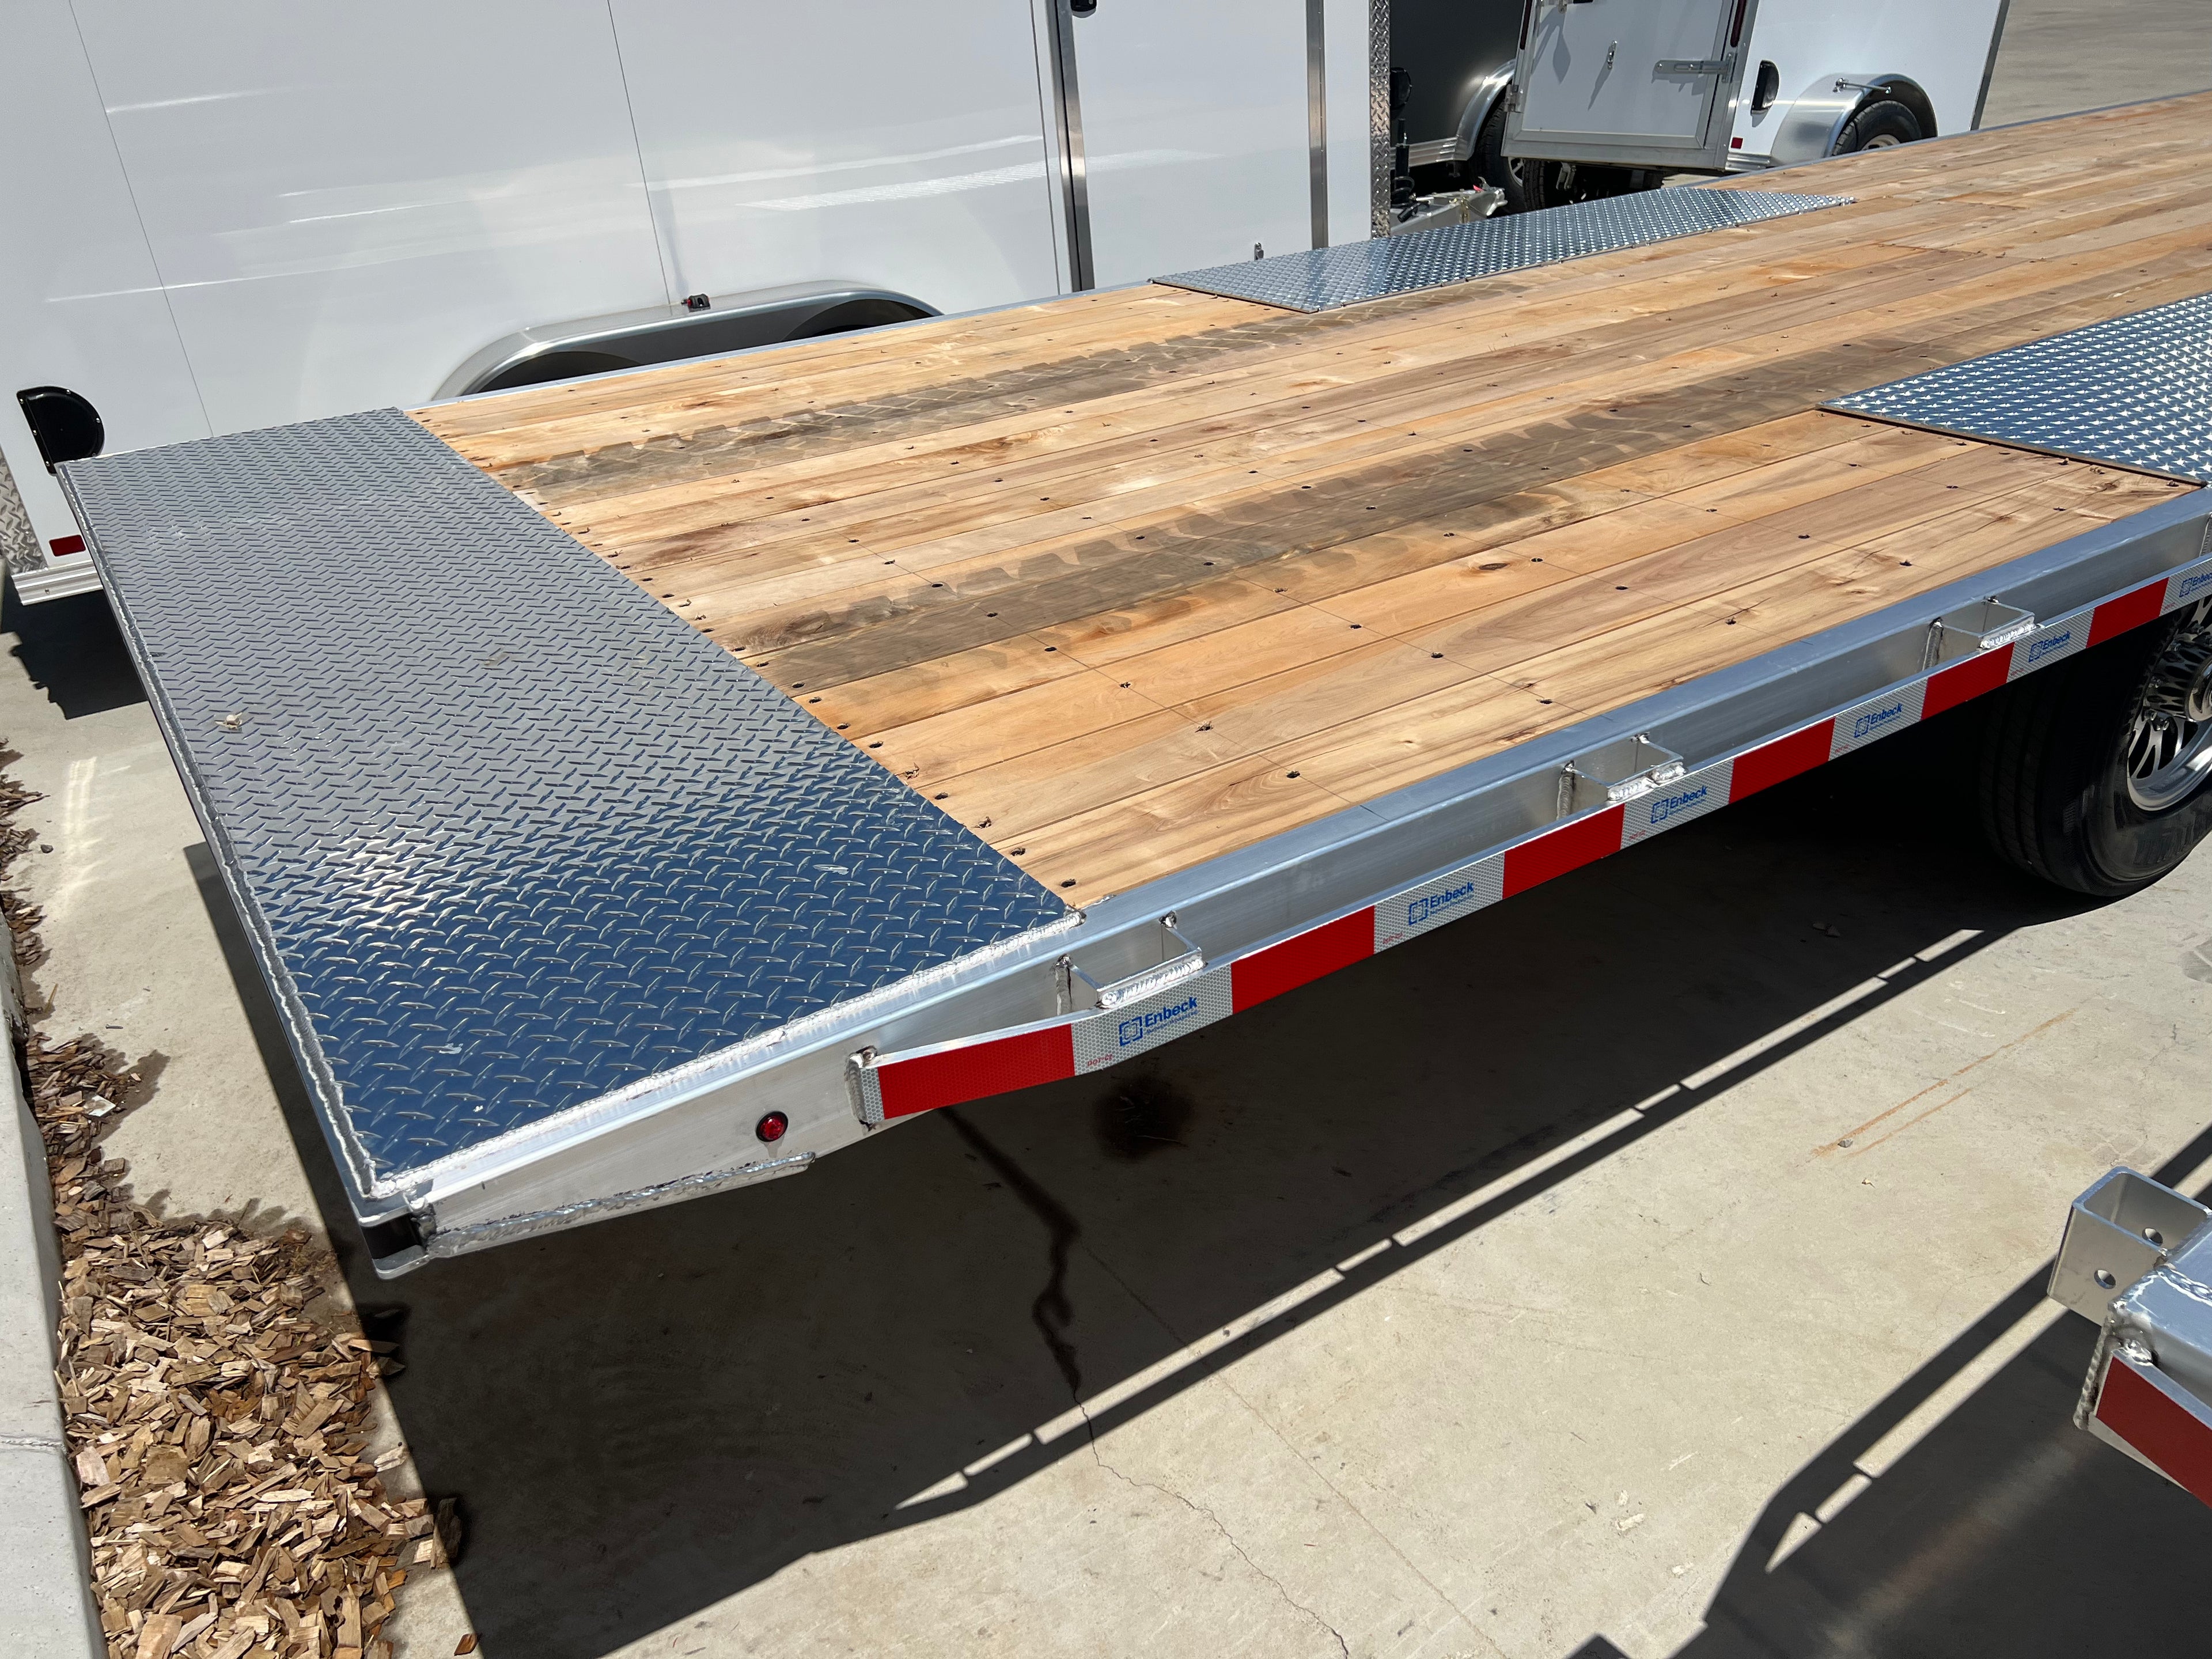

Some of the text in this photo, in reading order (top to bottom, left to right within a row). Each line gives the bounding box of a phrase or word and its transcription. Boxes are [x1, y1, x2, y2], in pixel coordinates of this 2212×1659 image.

[1870, 703, 1902, 724] Enbeck
[1670, 786, 1707, 808] Enbeck
[1430, 882, 1474, 908] Enbeck
[1144, 997, 1198, 1027] Enbeck
